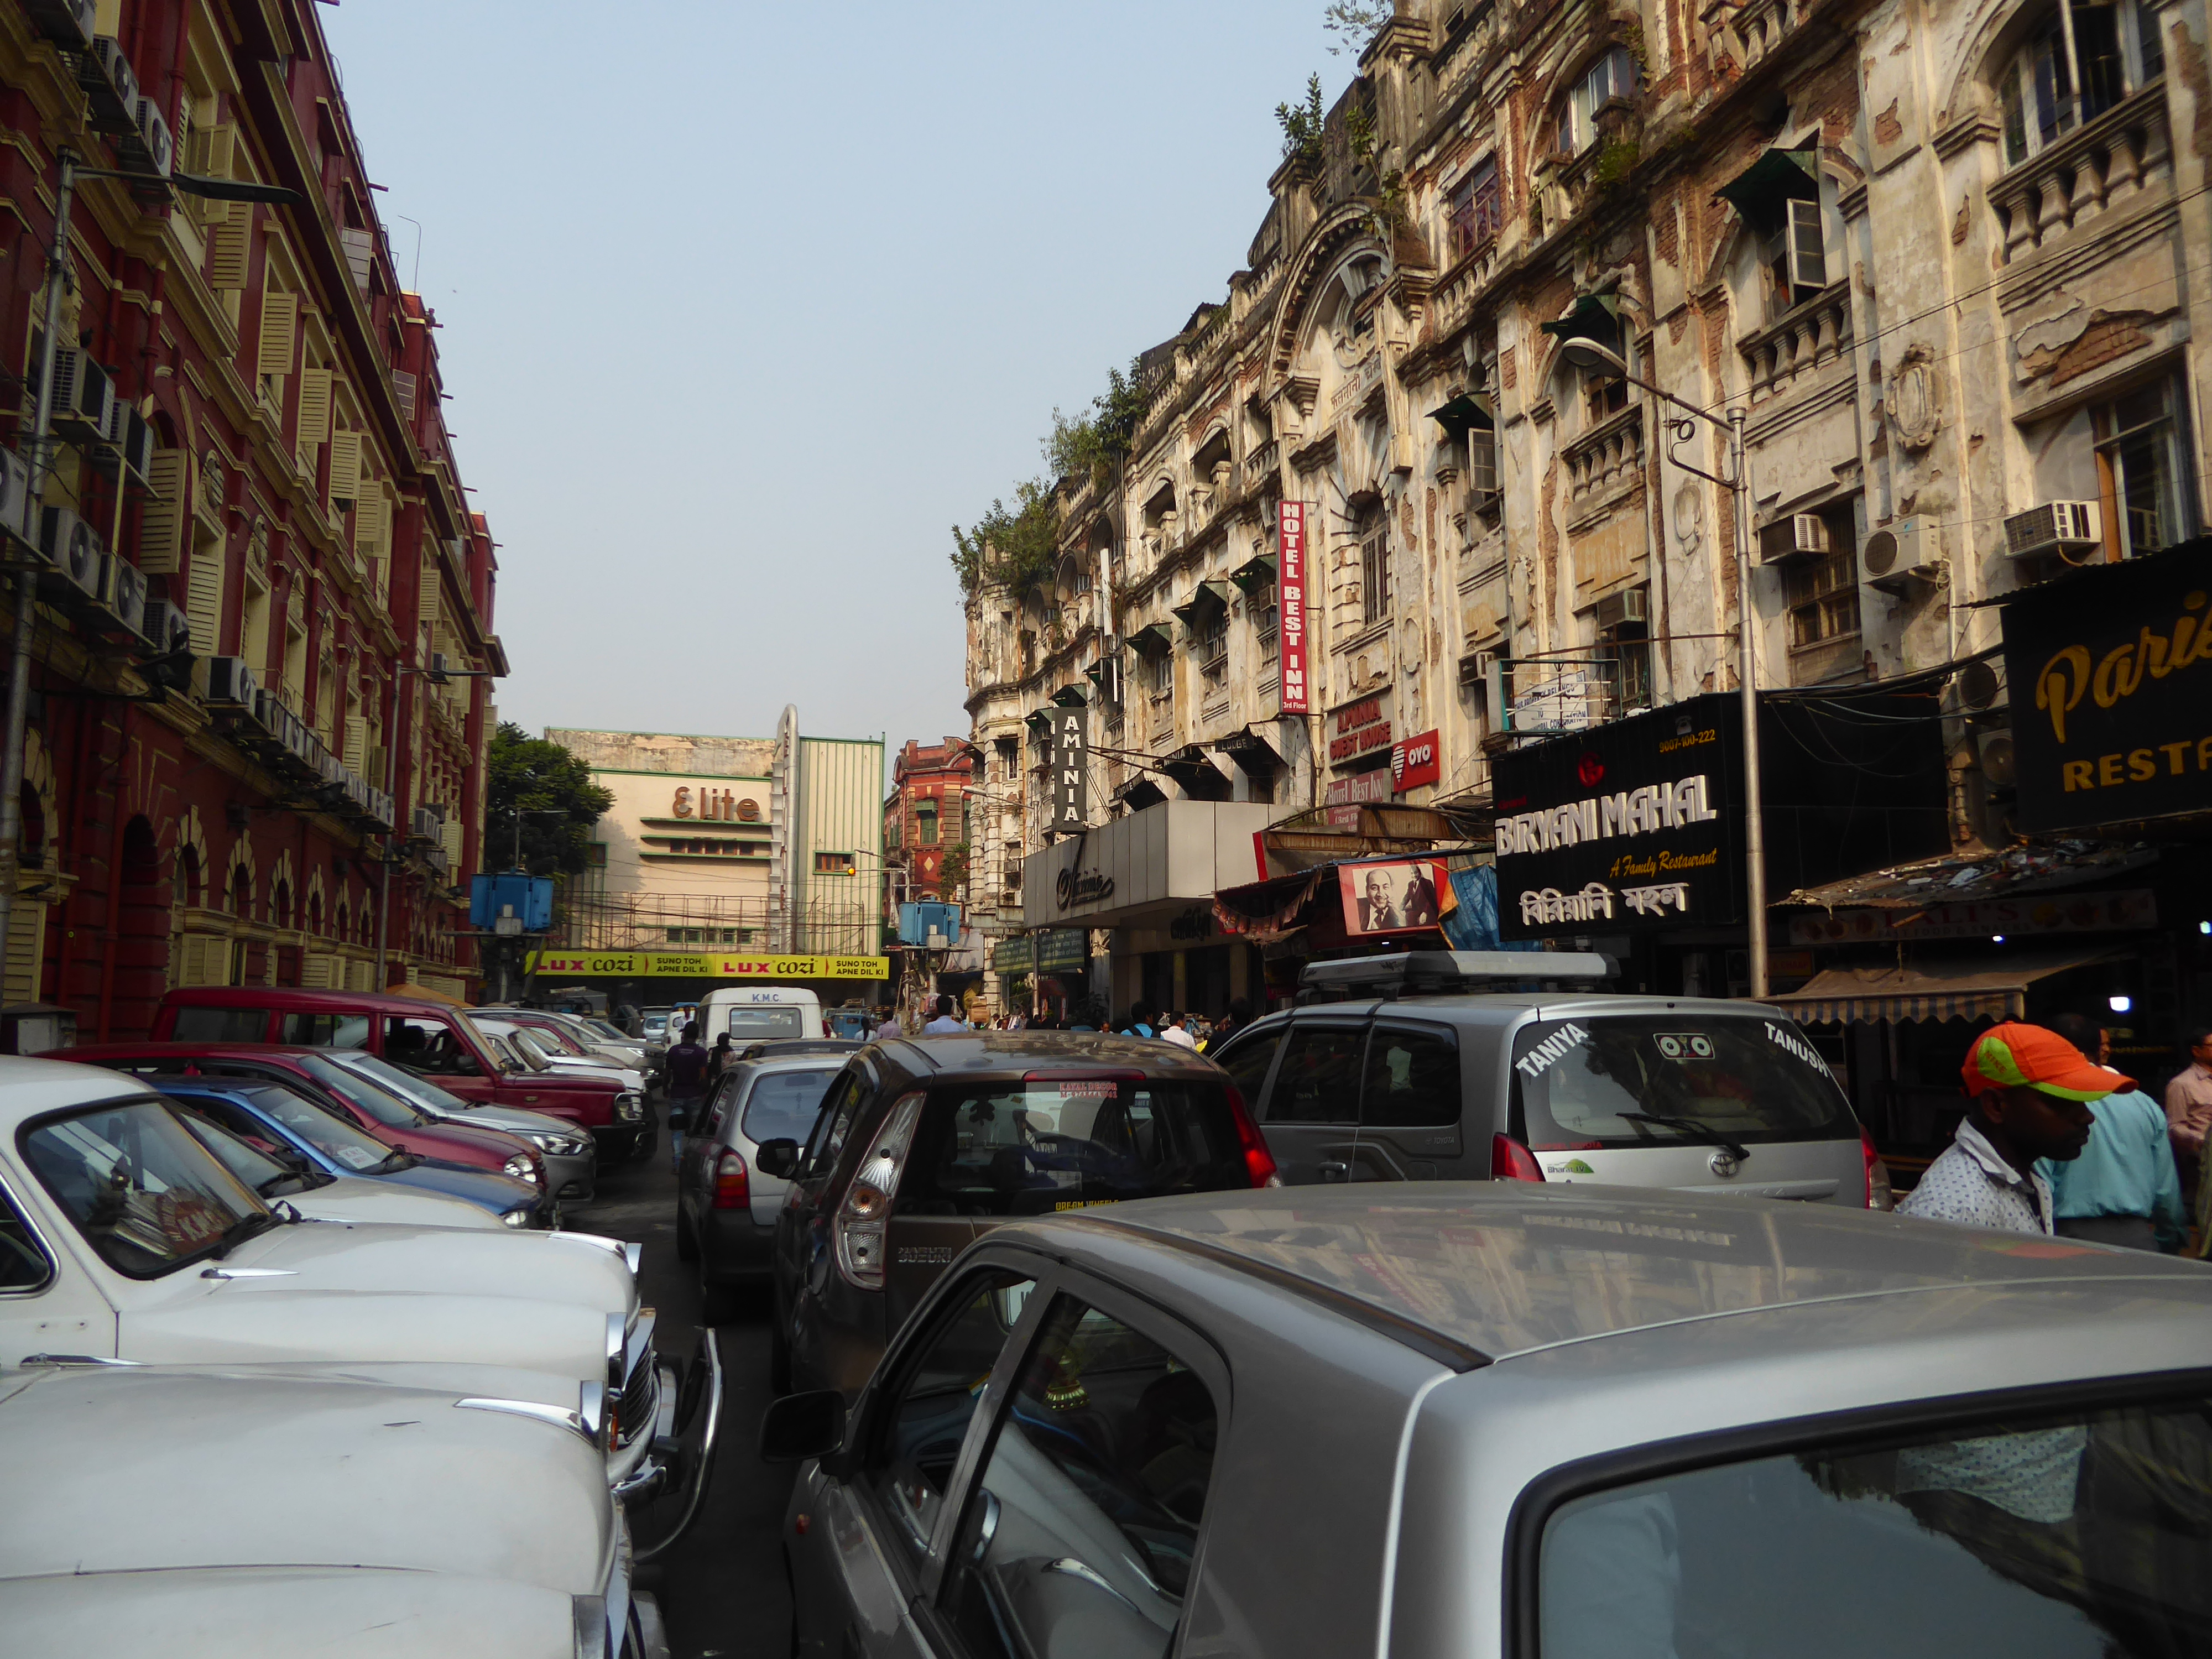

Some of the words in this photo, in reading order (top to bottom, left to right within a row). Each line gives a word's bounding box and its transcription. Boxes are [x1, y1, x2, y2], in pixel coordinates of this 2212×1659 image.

[1282, 503, 1300, 578] HOTEL
[1284, 586, 1301, 646] BEST
[1286, 655, 1302, 700] INN
[1547, 684, 1574, 696] BELNGS
[1337, 698, 1381, 734] AMINIA
[1550, 711, 1586, 729] CORORATION
[1221, 738, 1247, 751] LODGE
[1329, 733, 1358, 761] GUEST
[1359, 721, 1391, 751] HOUSE
[1658, 728, 1715, 753] 9007-100-222
[1062, 716, 1081, 821] AMINIA
[1408, 744, 1431, 766] OYO
[1116, 781, 1134, 798] LODE
[1328, 781, 1348, 805] HOTEL
[1352, 779, 1369, 802] BEST
[1370, 774, 1383, 800] INN
[672, 786, 760, 822] Elite
[1495, 799, 1598, 857] BIRYANI
[1600, 775, 1717, 837] MAHAL
[1609, 858, 1620, 878] A
[1622, 854, 1656, 878] Family
[1657, 848, 1717, 871] Restaurant
[1518, 882, 1615, 926] বিরিয়ানি
[1620, 882, 1690, 917] মহল
[1914, 926, 1951, 936] FOOD
[592, 955, 635, 972] cozi
[723, 962, 771, 973] LUX
[777, 958, 816, 974] cozi
[752, 993, 782, 1002] K.M.C.
[1515, 1022, 1590, 1078] TANIYA
[1764, 1021, 1828, 1078] TANUSH
[1088, 1082, 1118, 1091] DECOR
[1433, 1136, 1455, 1145] TOYOTA
[898, 1254, 952, 1263] SUZUKI
